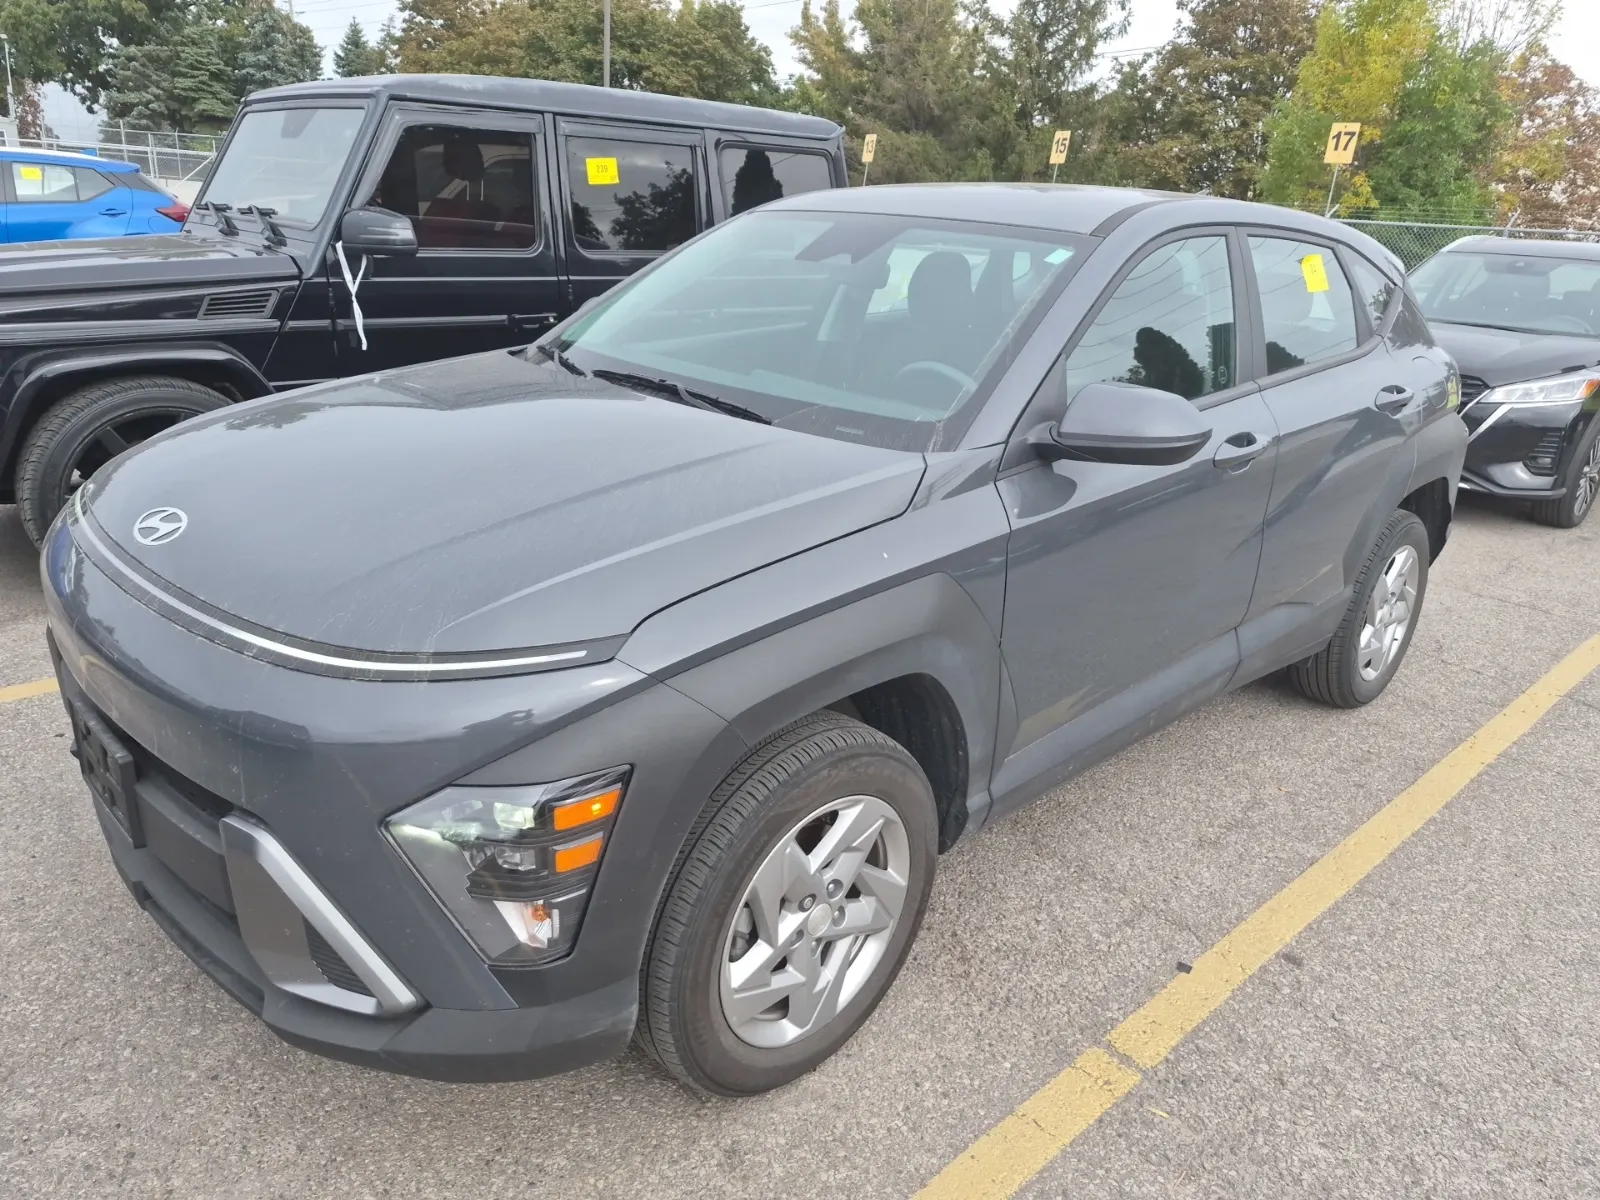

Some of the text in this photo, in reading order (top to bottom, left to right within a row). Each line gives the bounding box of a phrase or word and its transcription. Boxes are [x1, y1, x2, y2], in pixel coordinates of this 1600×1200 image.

[1055, 137, 1067, 154] 15
[1332, 131, 1356, 151] 17
[596, 164, 609, 173] 239
